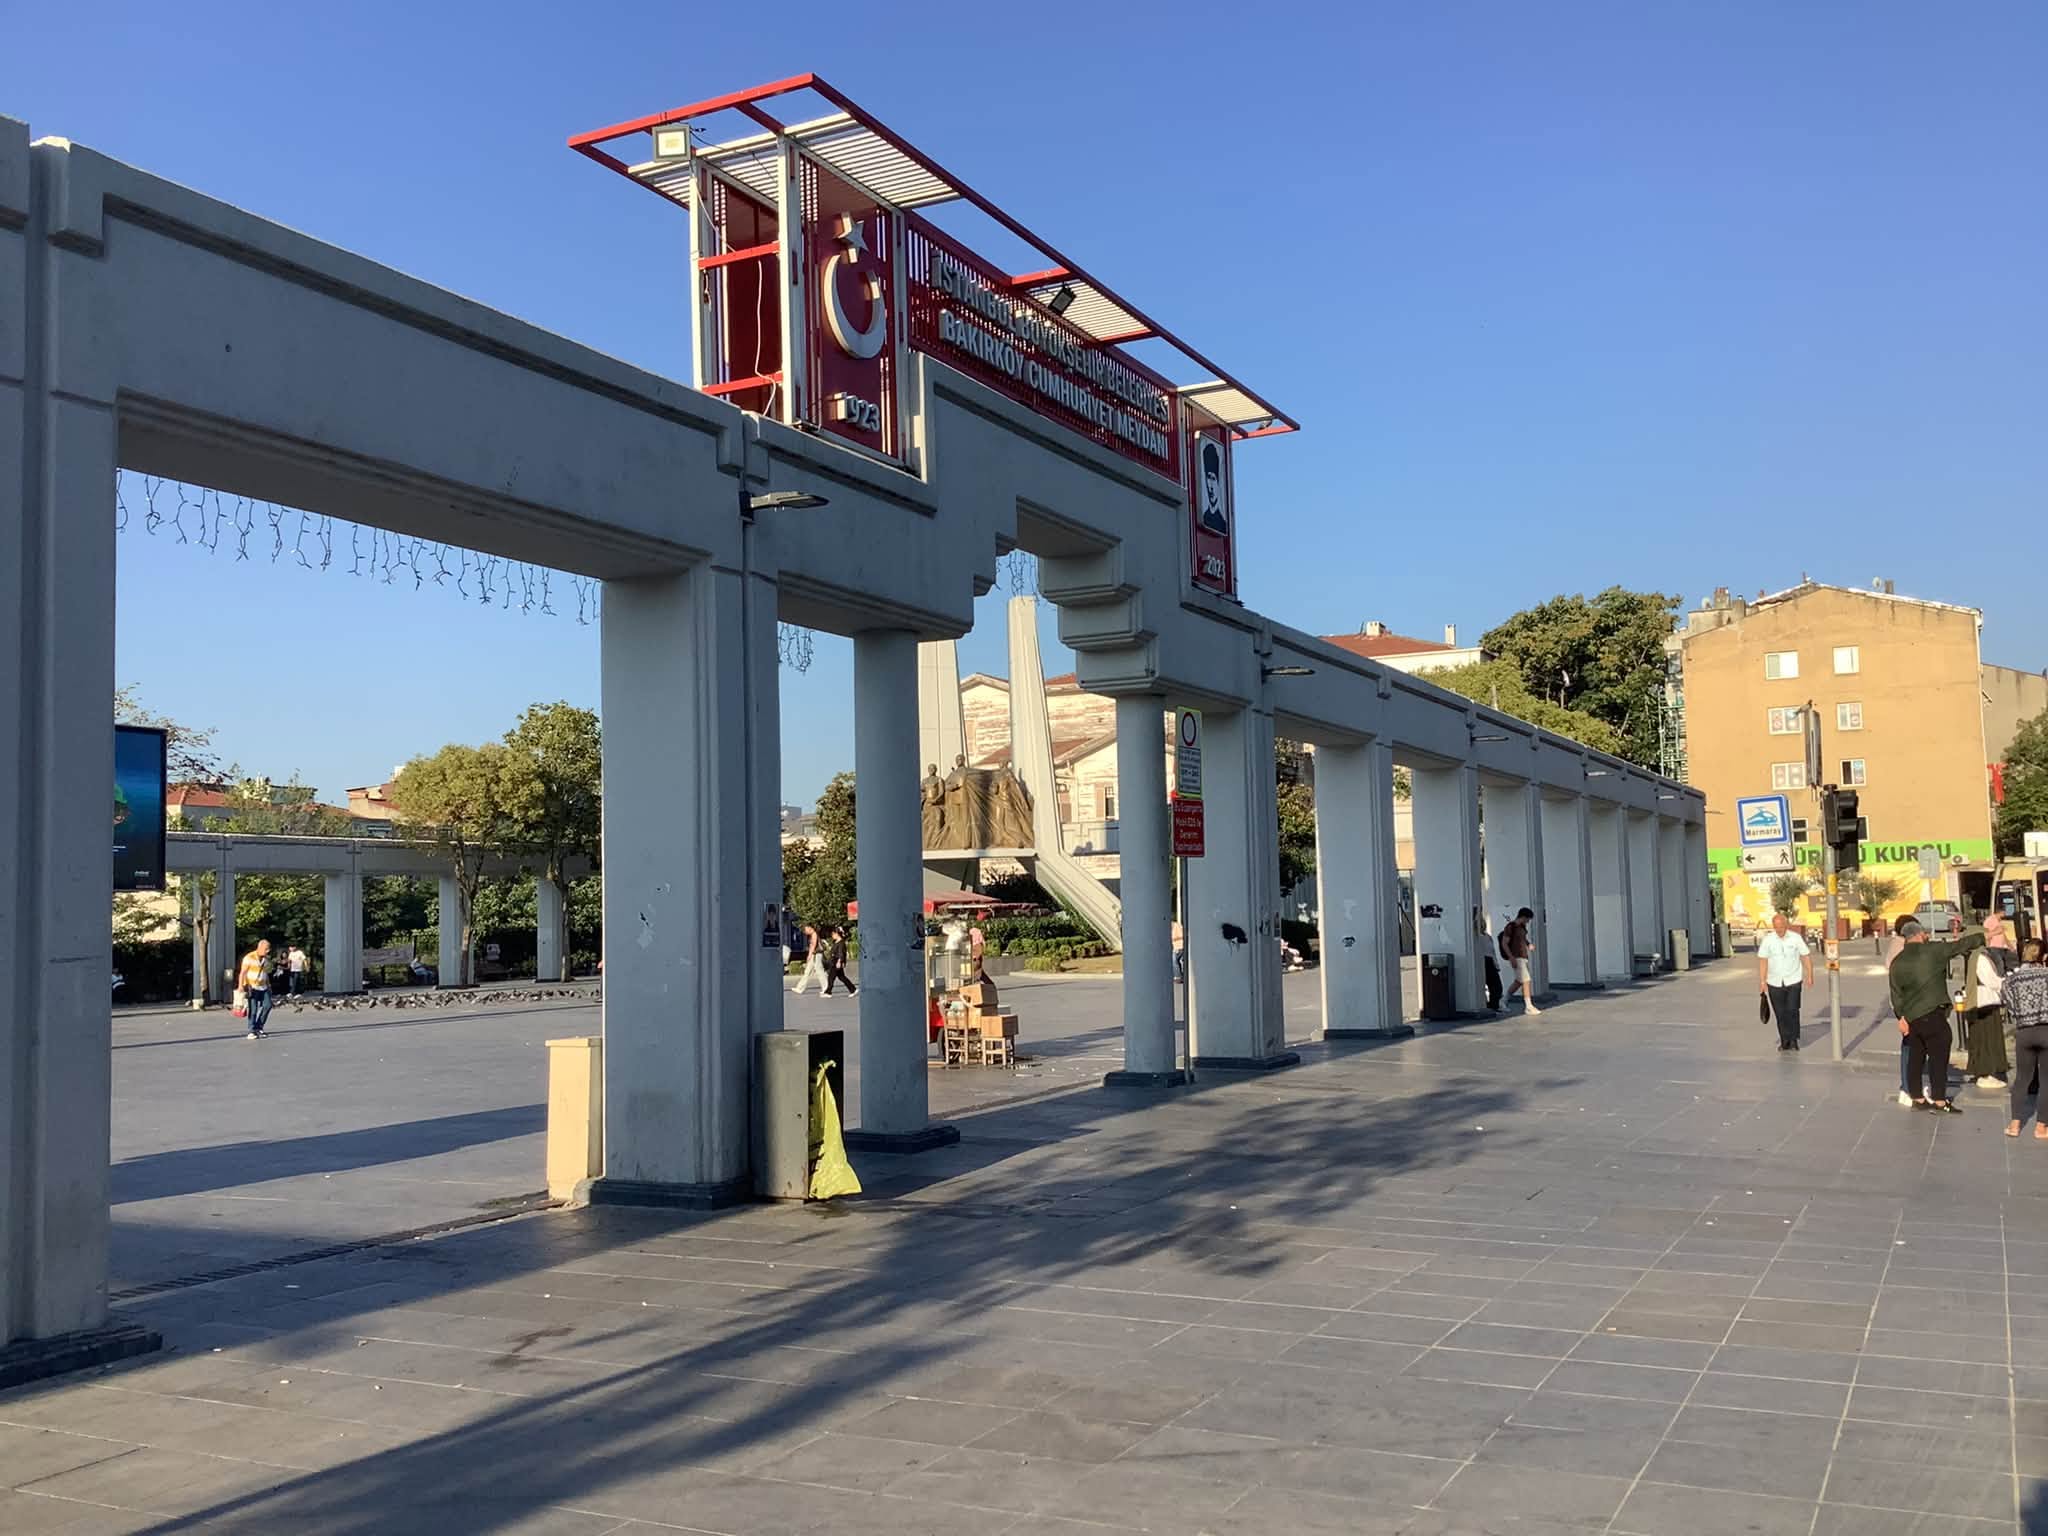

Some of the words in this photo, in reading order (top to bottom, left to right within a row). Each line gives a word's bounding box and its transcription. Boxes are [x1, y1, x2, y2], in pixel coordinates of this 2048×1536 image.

[931, 249, 1016, 333] İSTANBUL
[939, 308, 1024, 380] BAKIRKÖY
[1024, 359, 1115, 431] CUMHURİYET
[1115, 406, 1168, 461] MEYDANI
[834, 391, 880, 432] 1923
[1745, 828, 1781, 837] Marmaray
[1876, 842, 1951, 863] KURU
